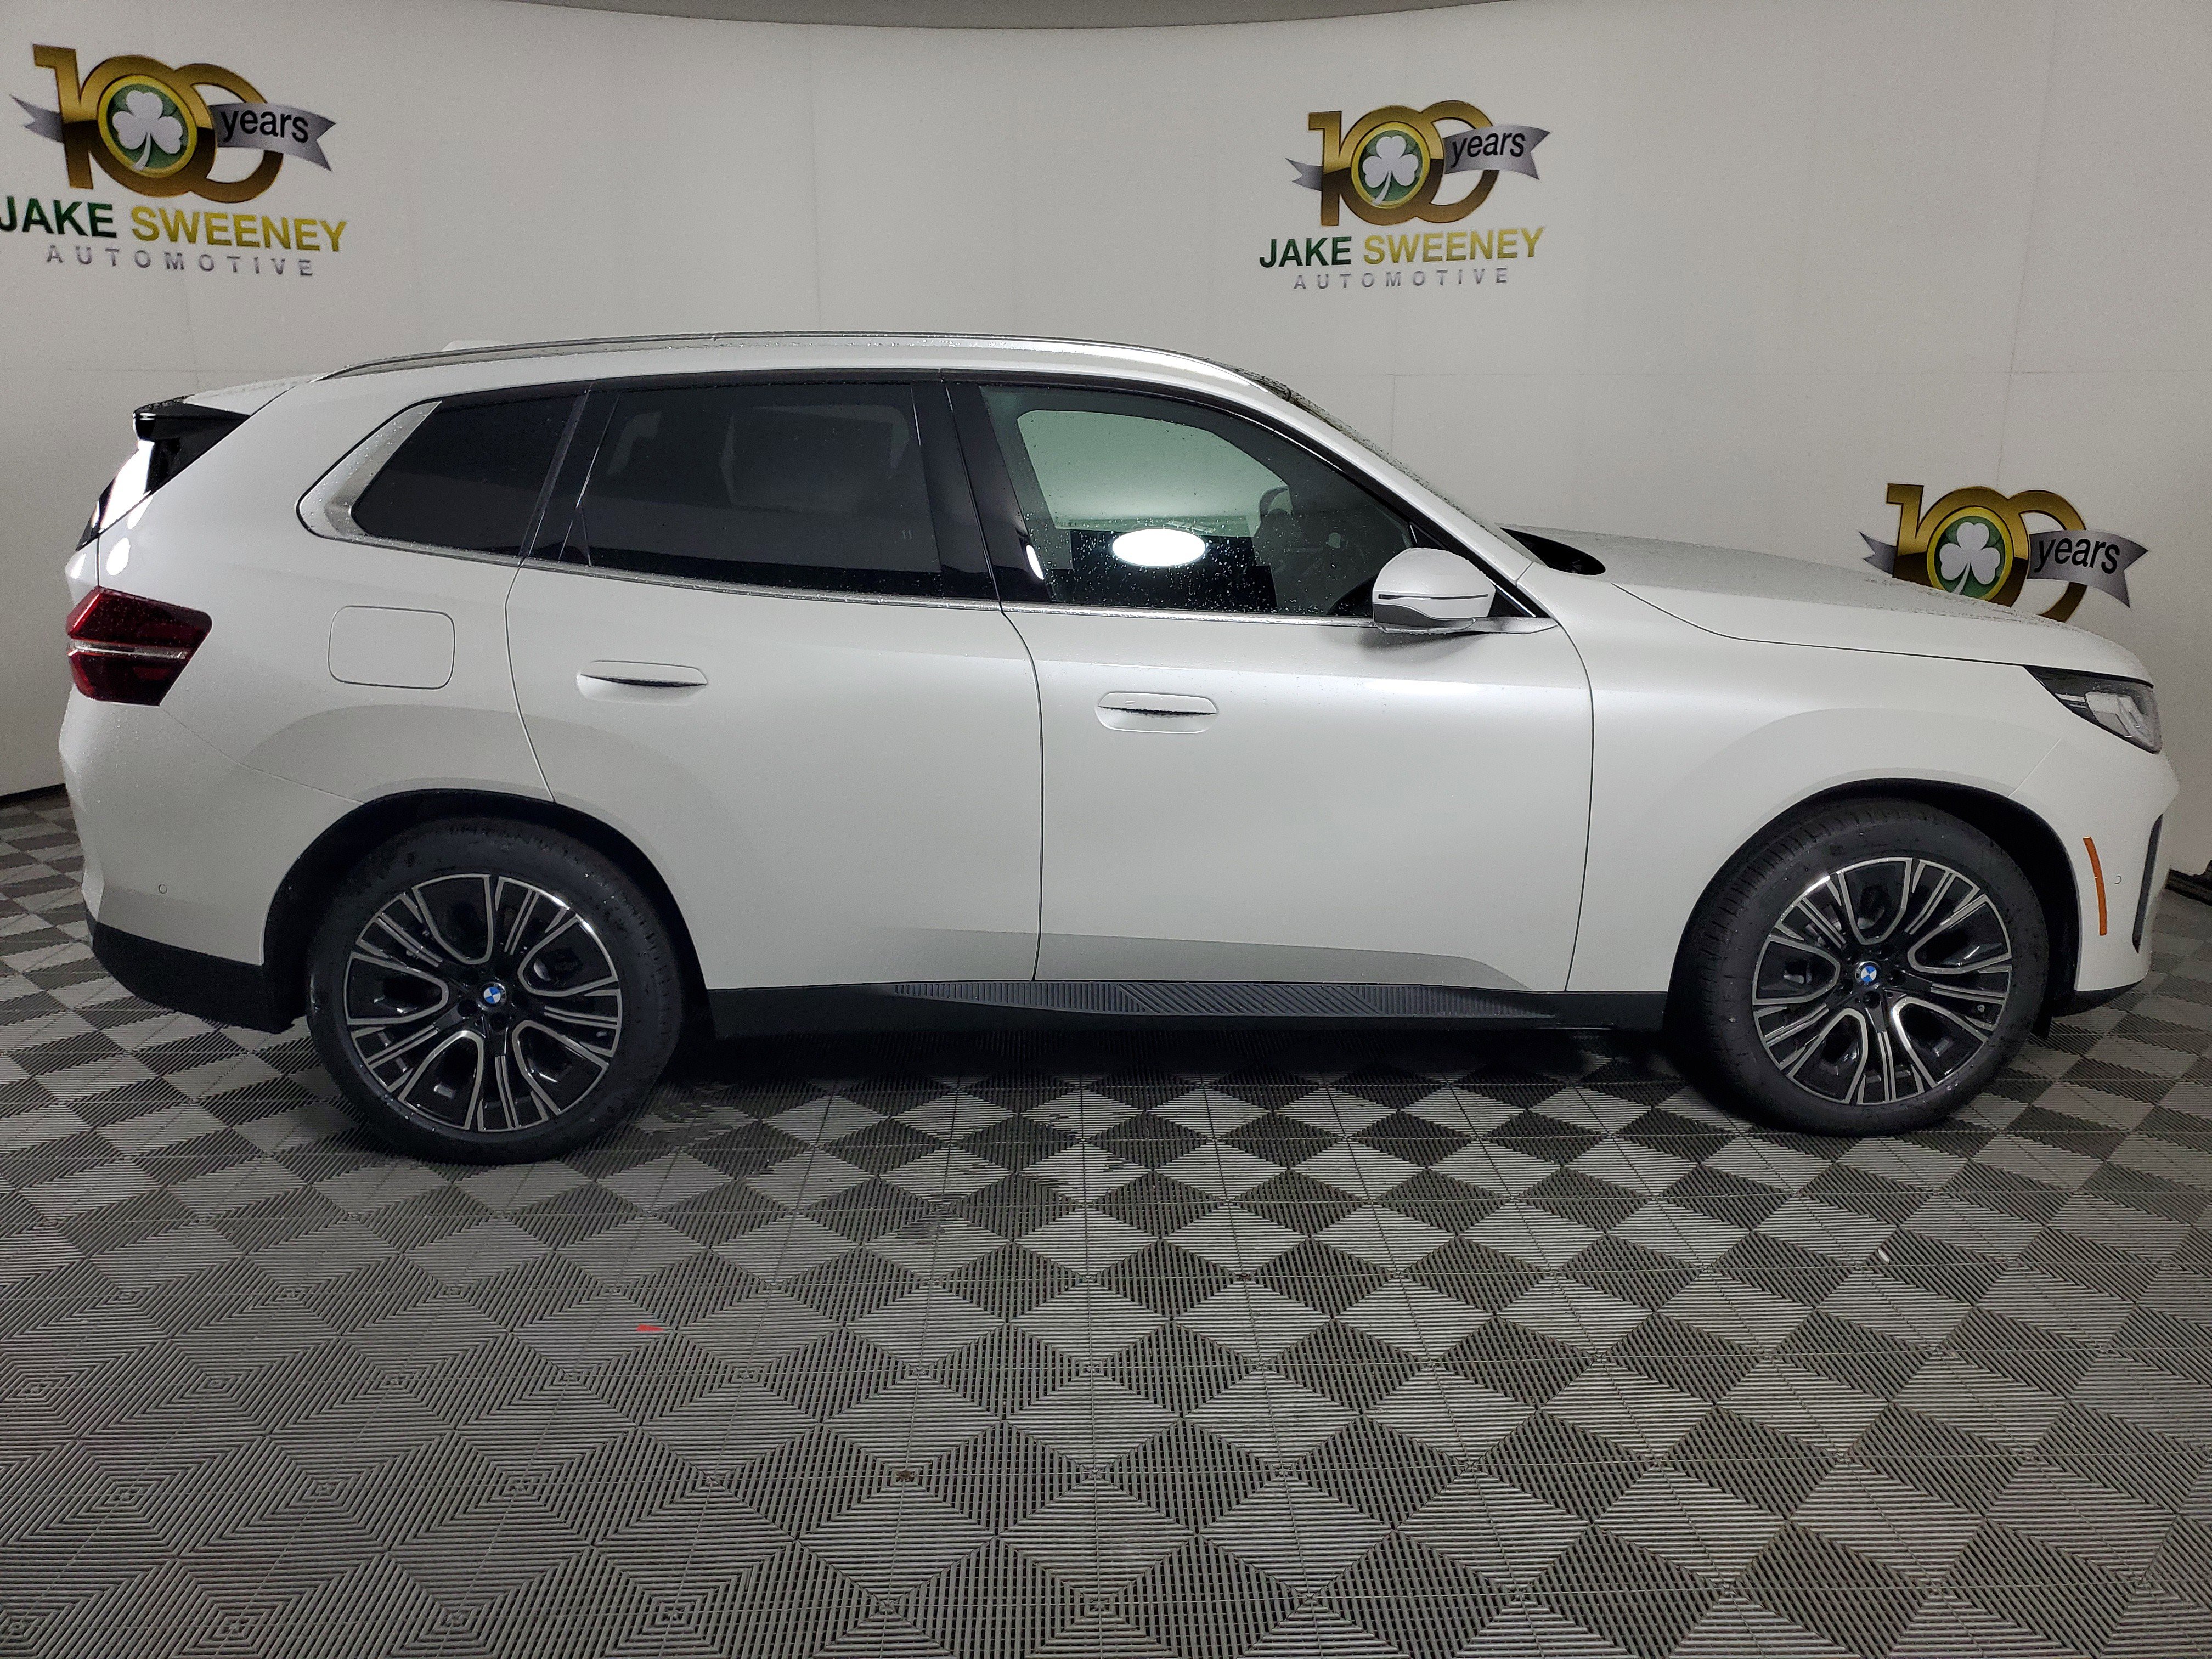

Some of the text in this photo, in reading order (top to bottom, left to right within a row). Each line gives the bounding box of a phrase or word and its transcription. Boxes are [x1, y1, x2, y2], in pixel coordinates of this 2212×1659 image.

[32, 44, 309, 204] 100 years
[1308, 100, 1526, 227] 100 years
[0, 196, 347, 252] JAKE SWEENEY
[1260, 226, 1545, 268] JAKE SWEENEY
[47, 245, 313, 276] AUTOMOTIVE
[1294, 267, 1508, 290] AUTOMOTIVE
[1886, 483, 2120, 623] 100 years
